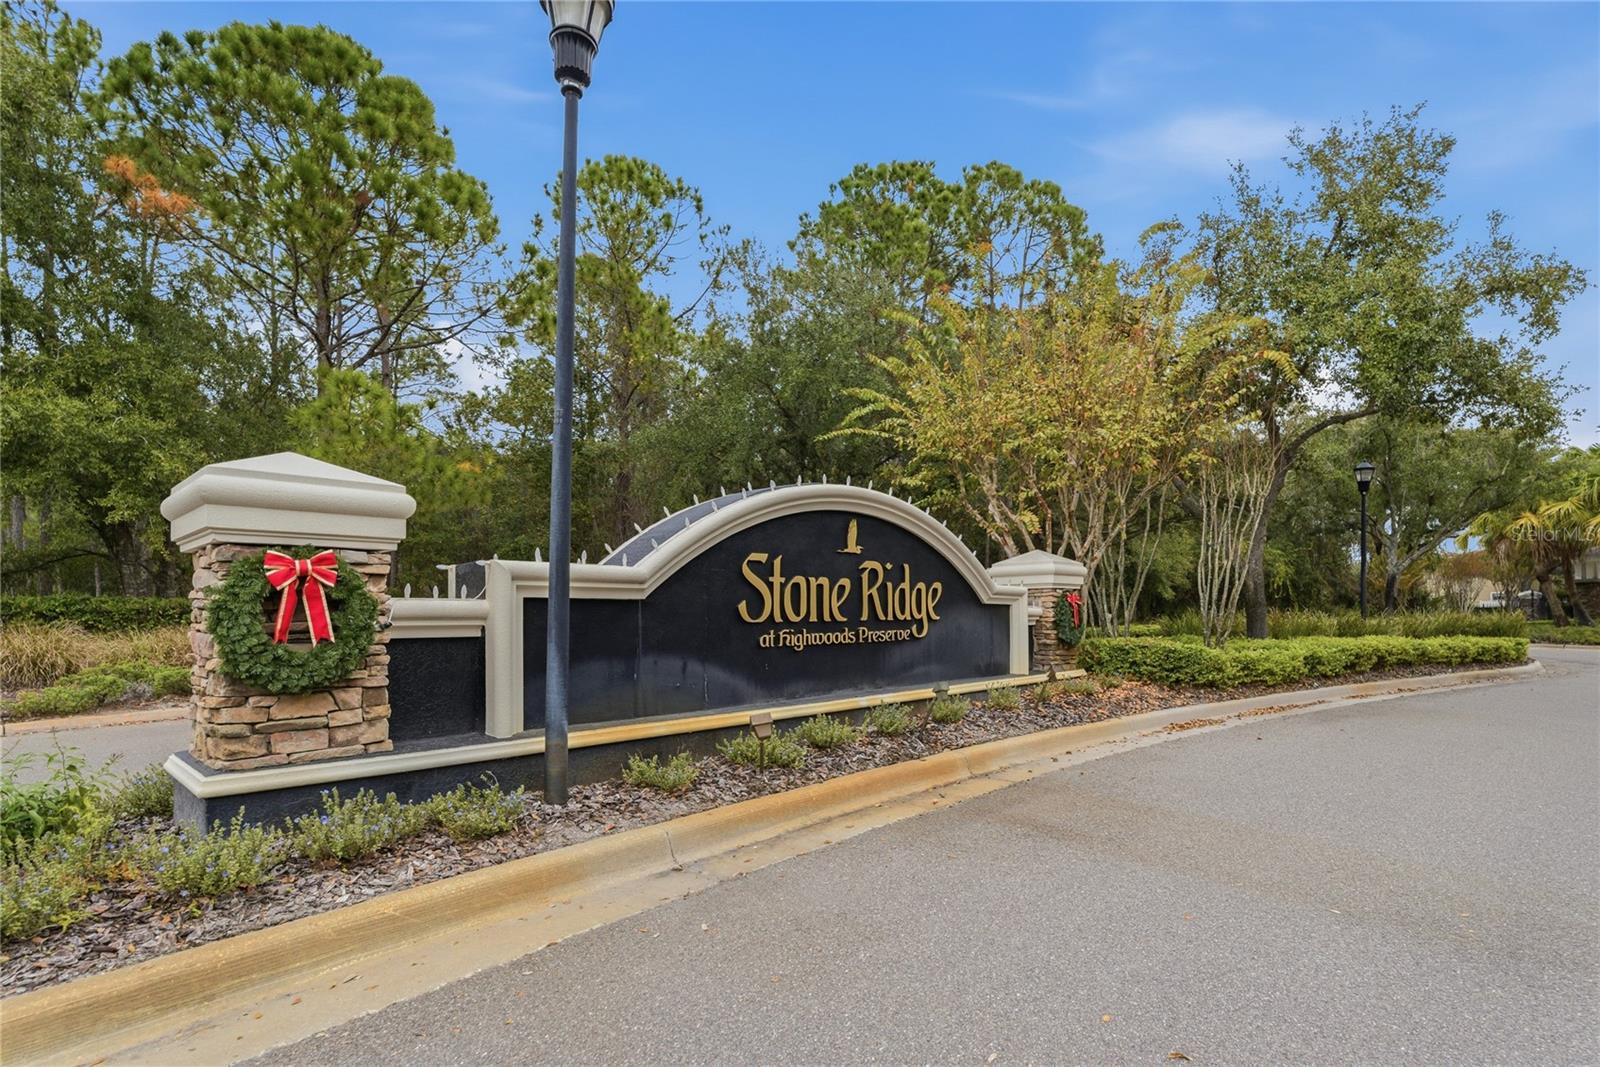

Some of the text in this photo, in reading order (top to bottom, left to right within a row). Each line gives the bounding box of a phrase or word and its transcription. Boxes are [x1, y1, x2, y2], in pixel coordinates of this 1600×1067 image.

[737, 552, 943, 638] Stone Ridge
[759, 626, 911, 651] at Highwoods Preserve
